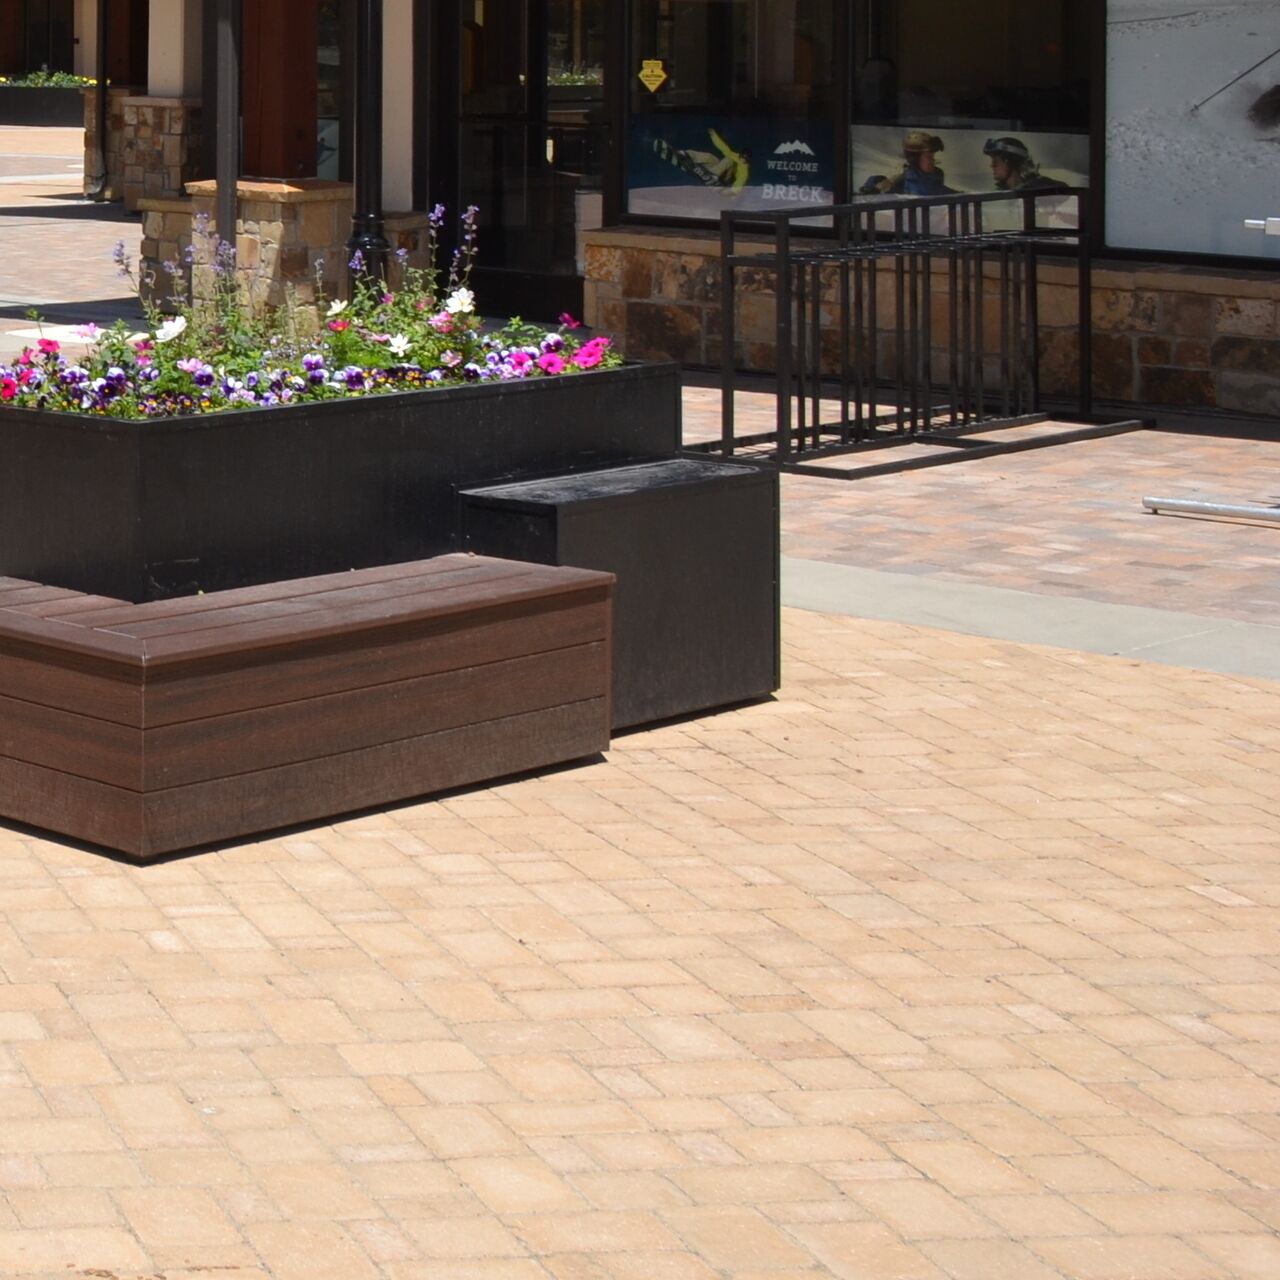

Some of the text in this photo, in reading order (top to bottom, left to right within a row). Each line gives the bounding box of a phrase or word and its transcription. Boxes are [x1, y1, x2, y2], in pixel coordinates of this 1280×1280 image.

[767, 160, 819, 172] WELCOME
[787, 174, 798, 182] TO
[761, 183, 824, 202] BRECK
